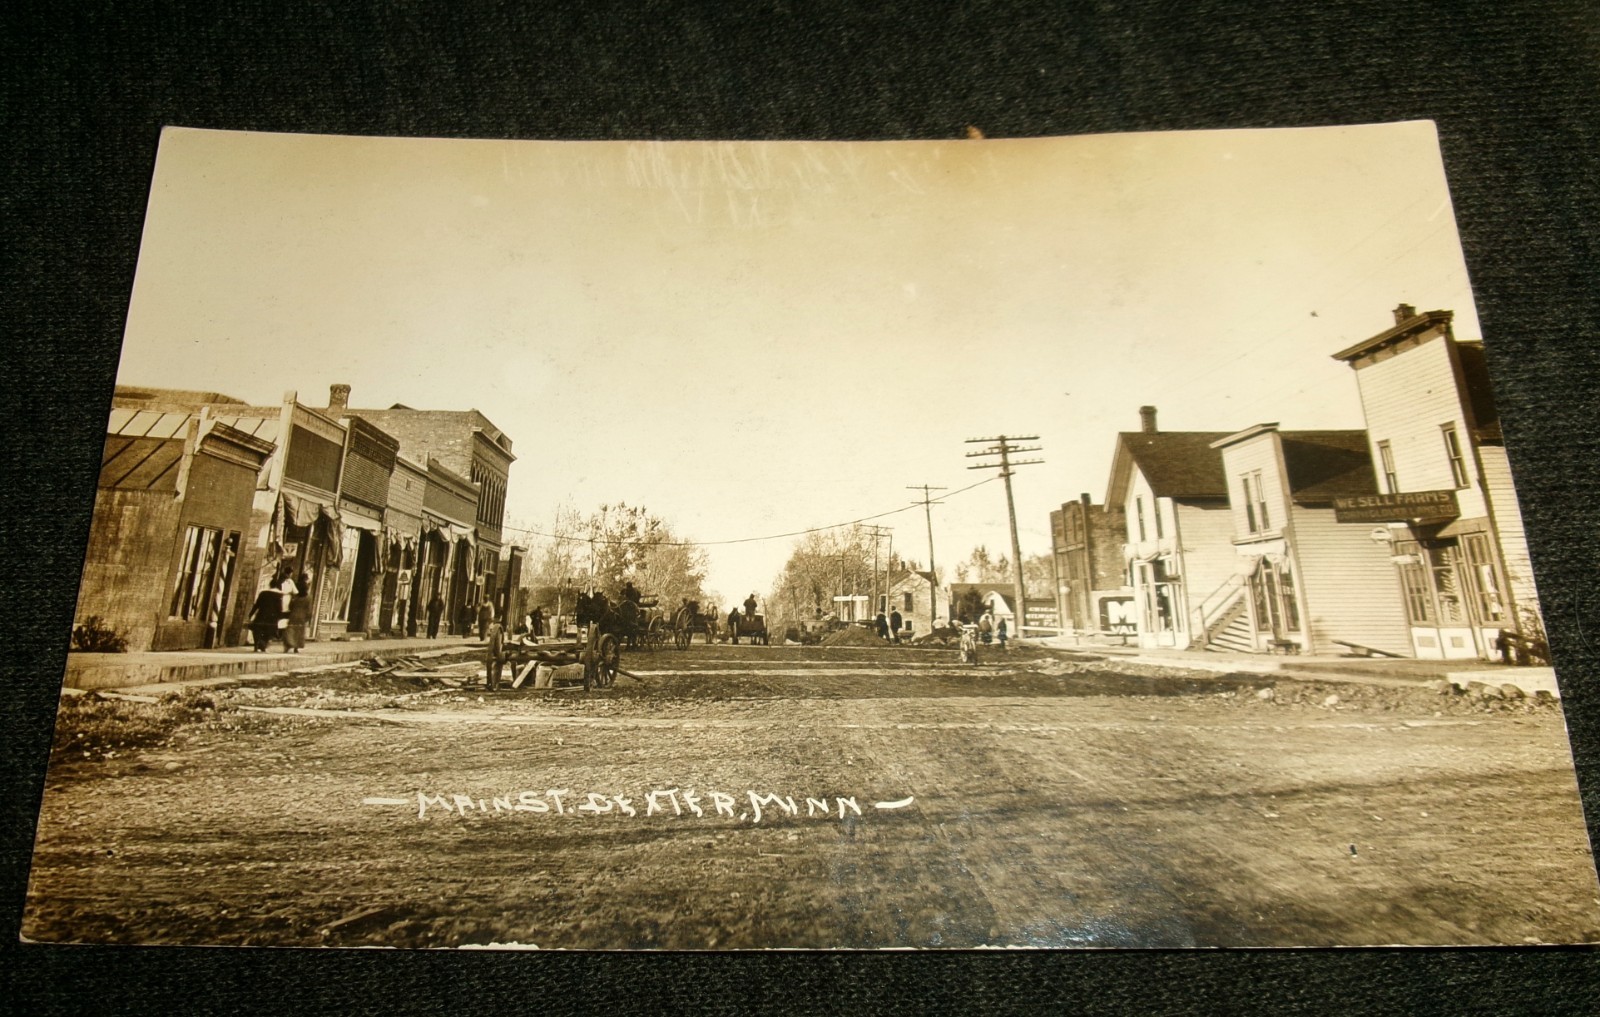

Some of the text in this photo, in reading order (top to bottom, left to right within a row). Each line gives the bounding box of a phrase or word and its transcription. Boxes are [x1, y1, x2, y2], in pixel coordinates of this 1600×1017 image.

[1336, 491, 1450, 509] WE SELL FARMS
[418, 792, 514, 819] MAIN
[747, 790, 861, 823] MINN
